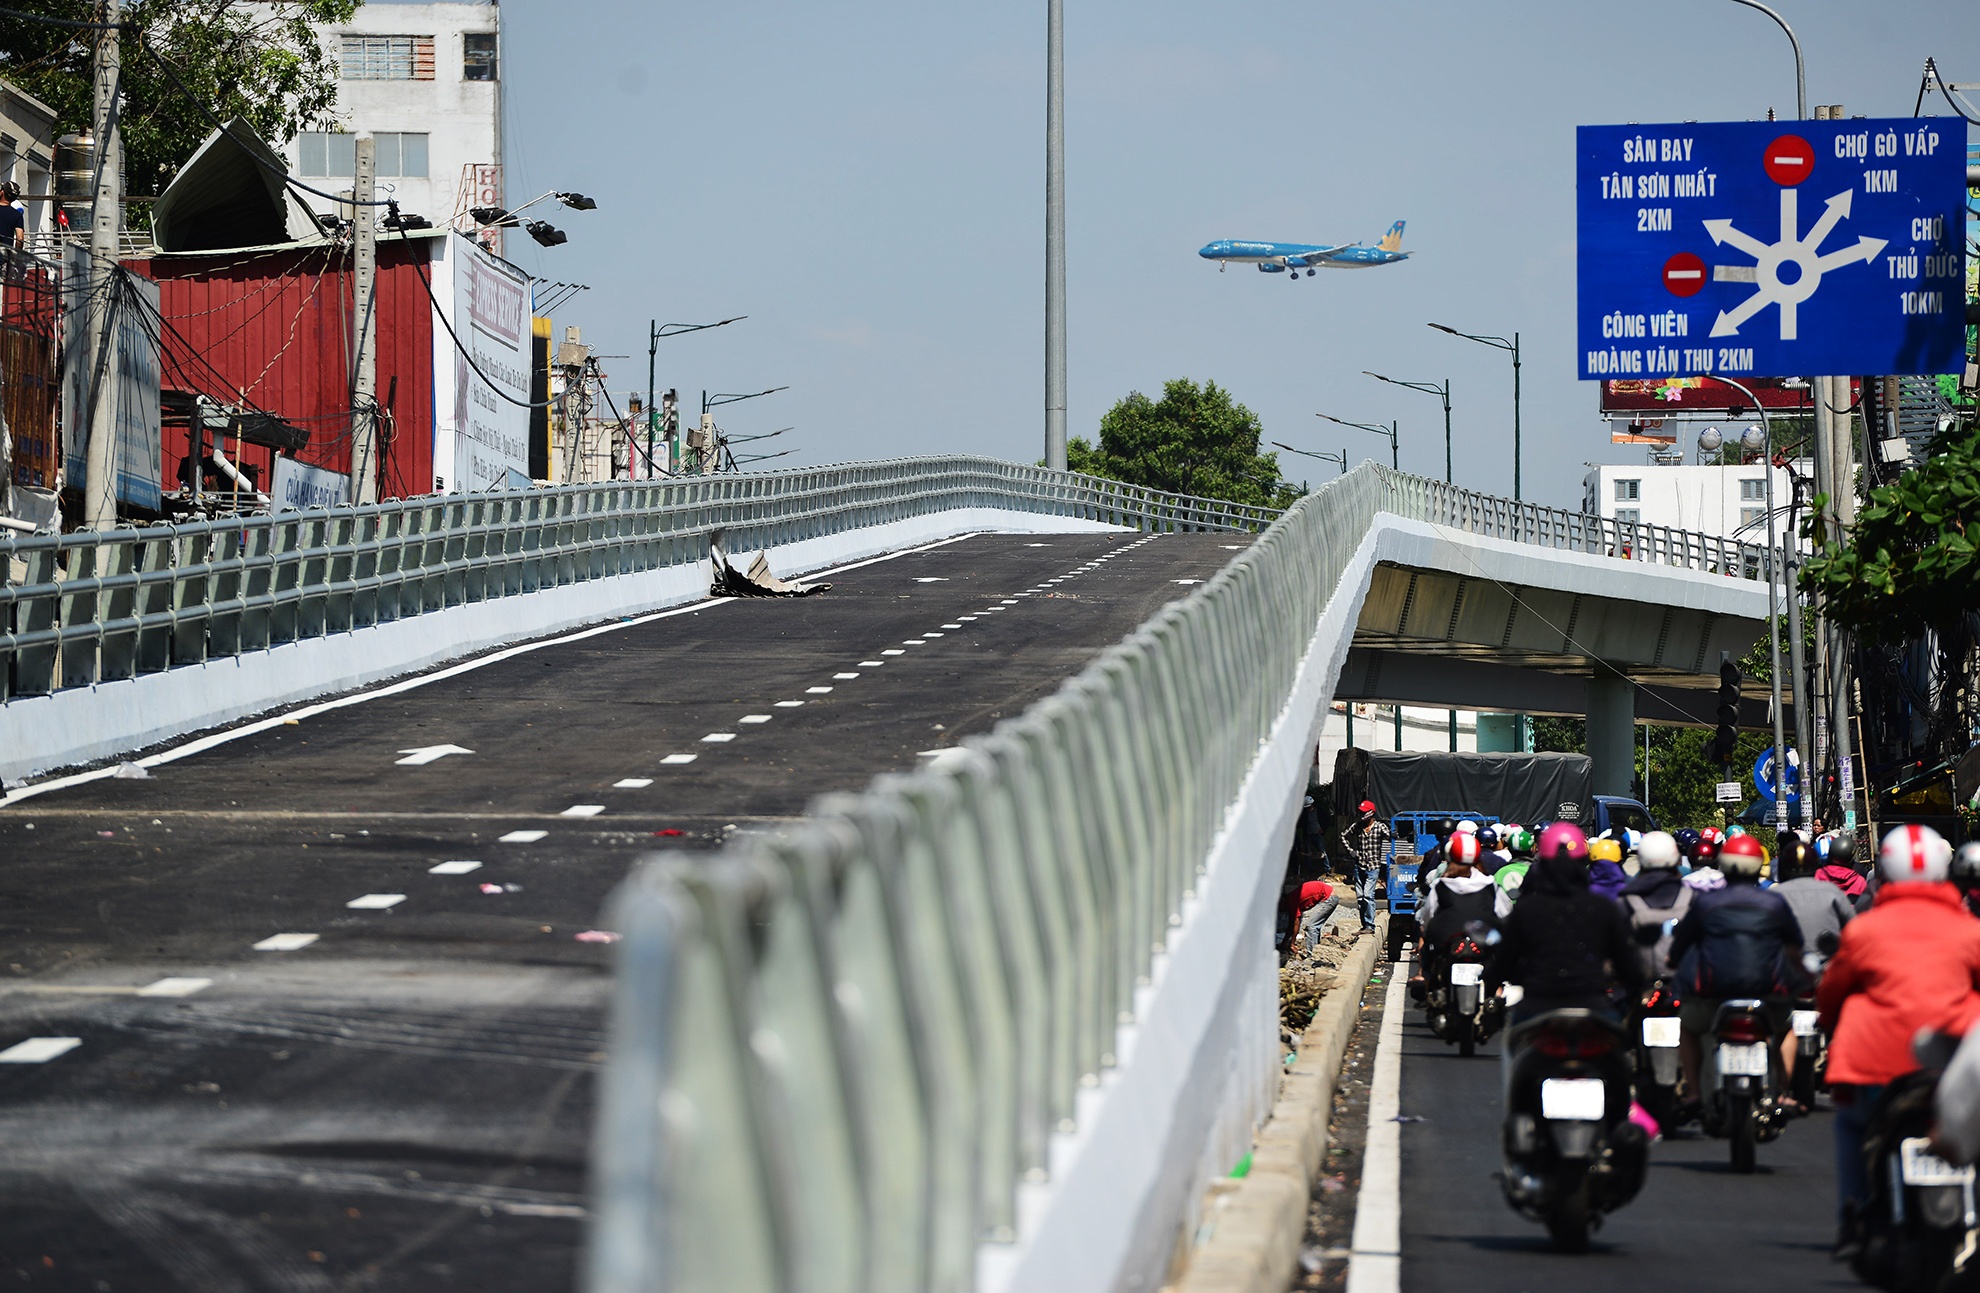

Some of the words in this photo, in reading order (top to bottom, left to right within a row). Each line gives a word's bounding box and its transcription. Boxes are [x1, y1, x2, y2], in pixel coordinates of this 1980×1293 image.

[1624, 135, 1656, 163] SÂN
[1661, 138, 1693, 162] BAY
[1835, 131, 1868, 164] CHỢ
[1875, 128, 1897, 157] GÒ
[1904, 125, 1939, 156] VẤP
[1600, 171, 1633, 199] TÂN
[1638, 172, 1669, 198] SƠN
[1674, 167, 1717, 198] NHẤT
[1863, 169, 1898, 193] 1KM
[1637, 208, 1672, 232] 2KM
[1911, 214, 1944, 246] CHỢ
[1887, 247, 1919, 279] THỦ
[1925, 248, 1958, 279] ĐỨC
[1900, 292, 1943, 315] 10KM
[1603, 310, 1646, 339] CÔNG
[1650, 309, 1688, 337] VIÊN
[1587, 346, 1642, 374] HOÀNG
[1646, 346, 1679, 373] VĂN
[1684, 349, 1714, 376] THỤ
[1719, 348, 1754, 371] 2KM
